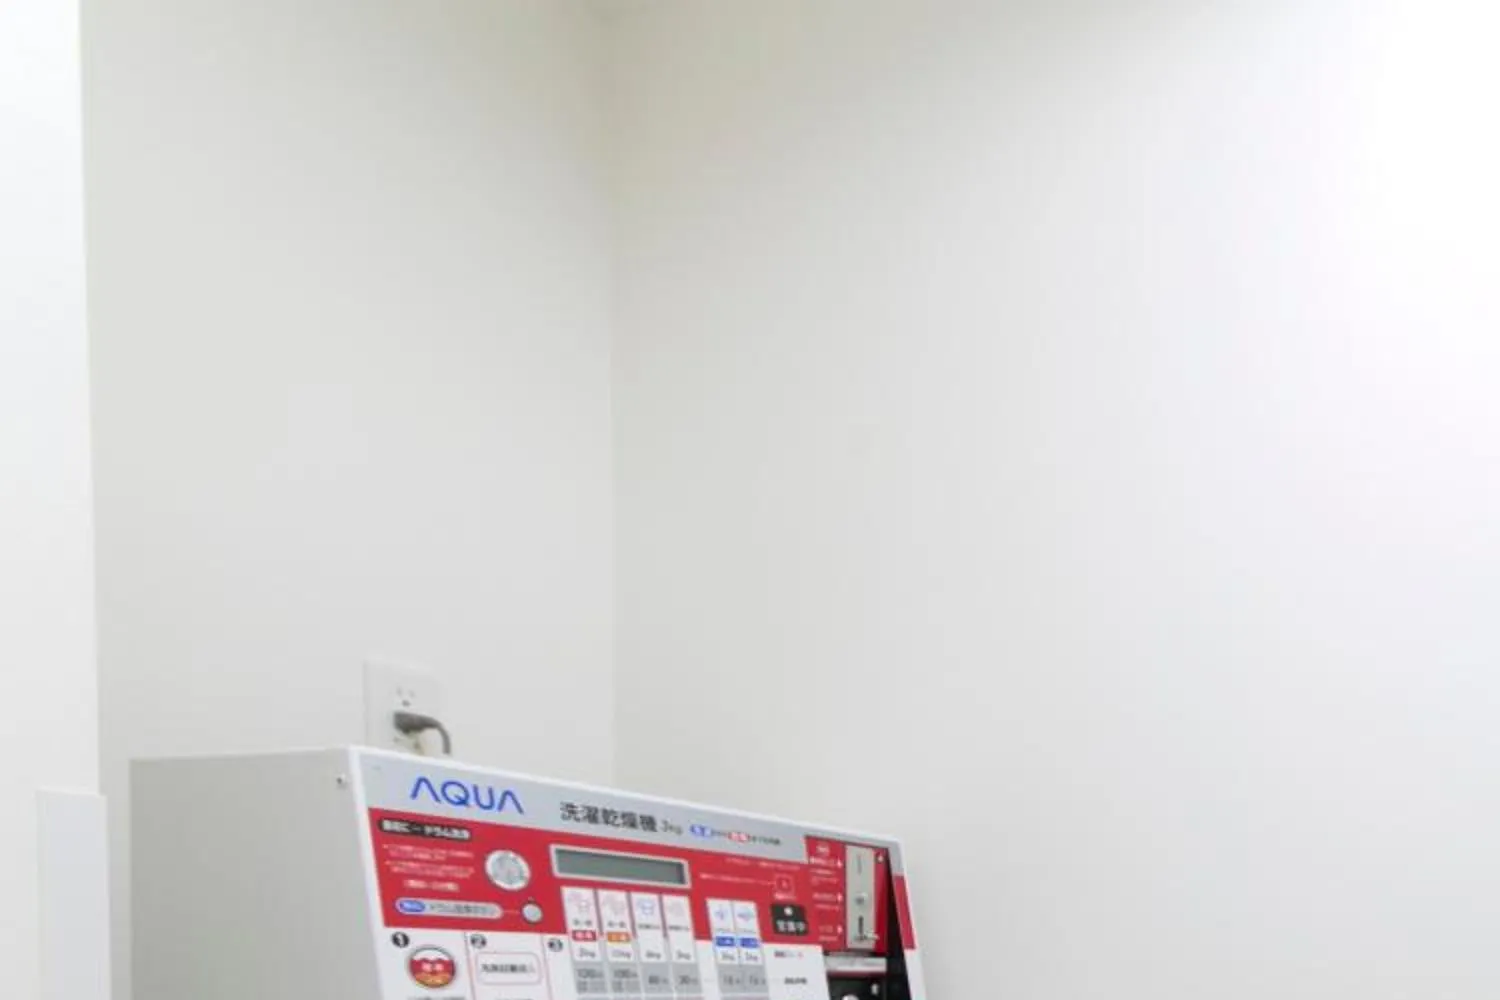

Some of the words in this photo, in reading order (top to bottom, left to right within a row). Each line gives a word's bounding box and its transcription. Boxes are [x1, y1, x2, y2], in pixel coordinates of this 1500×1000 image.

[410, 776, 525, 815] AQUA
[559, 801, 657, 832] 洗濯乾燥機
